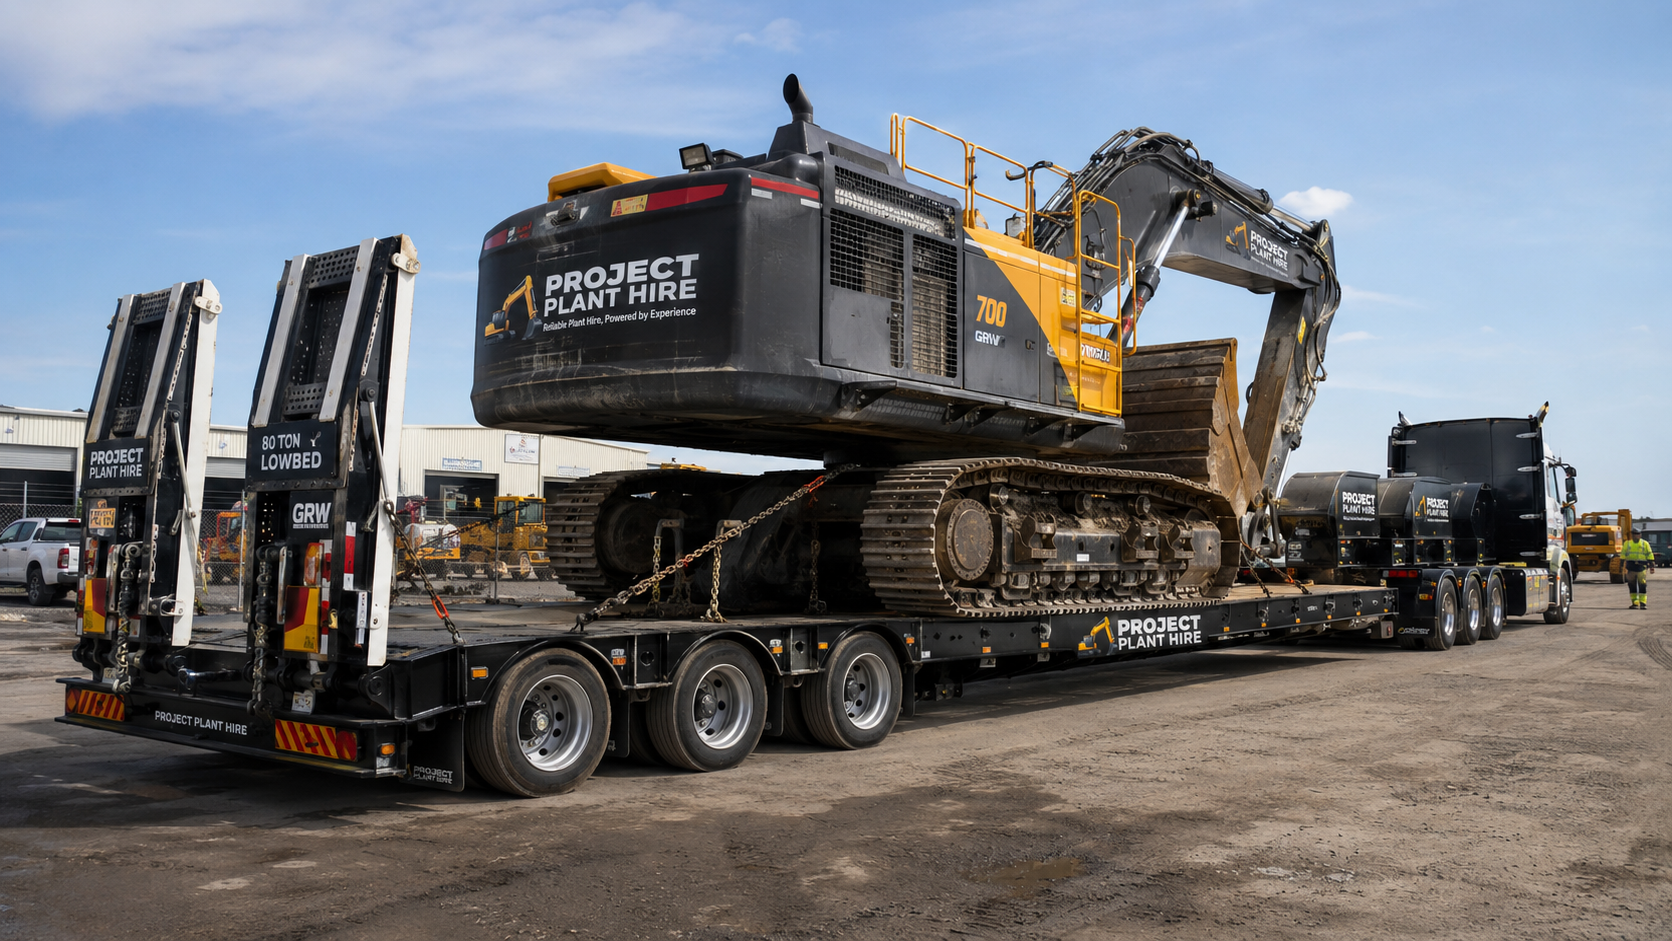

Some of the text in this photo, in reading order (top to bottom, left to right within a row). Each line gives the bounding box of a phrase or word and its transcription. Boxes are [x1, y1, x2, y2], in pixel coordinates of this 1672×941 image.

[1250, 229, 1288, 261] PROJECT
[545, 253, 700, 297] PROJECT
[543, 278, 697, 317] PLANT HIRE
[568, 317, 586, 329] Plant
[586, 315, 604, 325] Hire,
[605, 311, 637, 323] Powered
[638, 311, 648, 321] by
[650, 306, 697, 320] Experience
[976, 294, 1008, 328] 700
[261, 432, 301, 450] 80 TON
[90, 447, 144, 466] PROJECT
[261, 451, 322, 471] LOWBED
[89, 464, 143, 479] PLANT HIRE
[1342, 491, 1376, 506] PROJECT
[292, 502, 332, 524] GRW
[1117, 614, 1201, 636] PROJECT
[1118, 630, 1203, 651] PLANT HIRE
[155, 710, 248, 735] PROJECT PLANT HIRE
[413, 765, 453, 779] PROJECT
